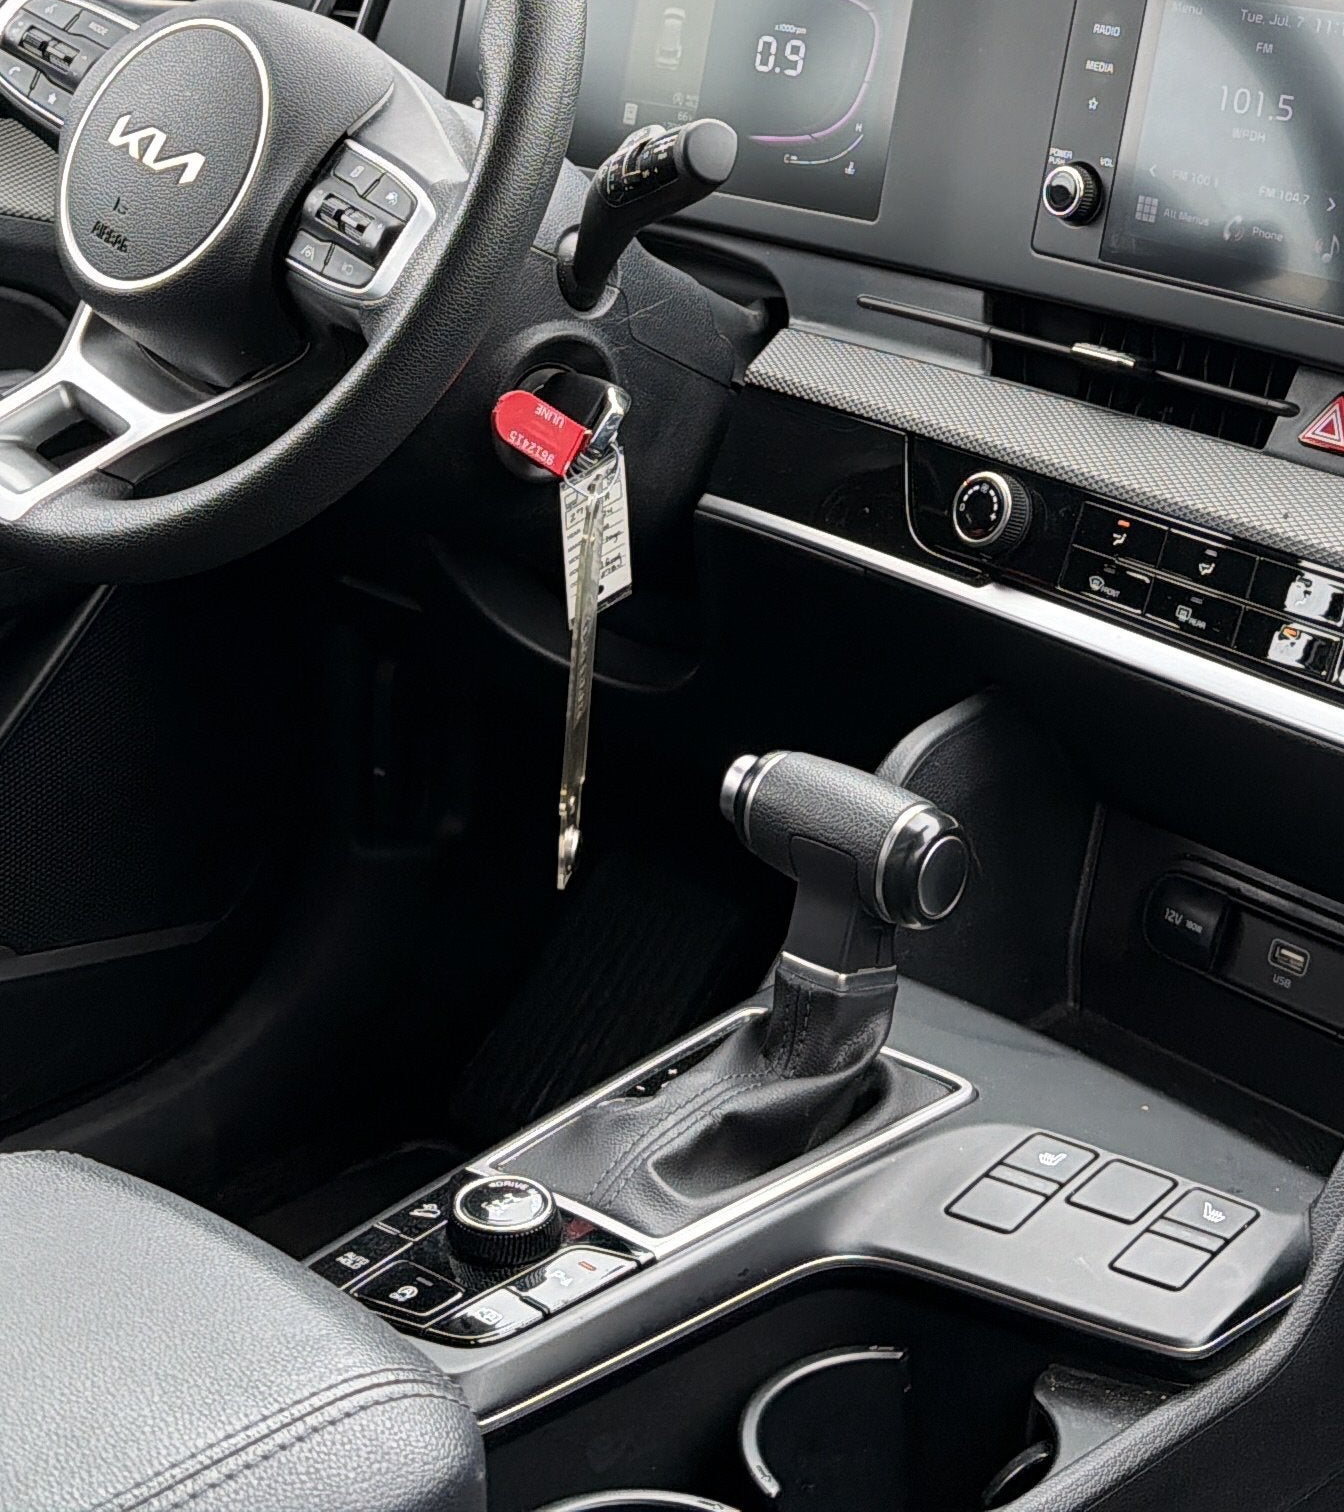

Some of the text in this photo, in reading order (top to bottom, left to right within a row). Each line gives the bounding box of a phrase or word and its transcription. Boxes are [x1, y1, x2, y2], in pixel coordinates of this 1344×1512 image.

[1173, 1, 1203, 16] Menu
[1296, 16, 1304, 28] 7
[1093, 23, 1121, 37] RADIO
[1255, 42, 1274, 54] FM
[754, 35, 806, 77] 0.9
[1085, 59, 1114, 74] MEDIA
[1219, 85, 1295, 122] 101.5
[1049, 147, 1073, 159] POWER
[1099, 156, 1114, 168] VOL
[1172, 169, 1189, 182] FM
[1259, 186, 1310, 206] FM 104.7
[1179, 210, 1210, 227] Menus
[1252, 226, 1285, 243] Phone
[534, 403, 565, 429] ULINE
[1100, 586, 1120, 598] FRONT
[1189, 617, 1206, 630] REAR
[1164, 907, 1184, 926] 12V
[1272, 973, 1292, 989] USB
